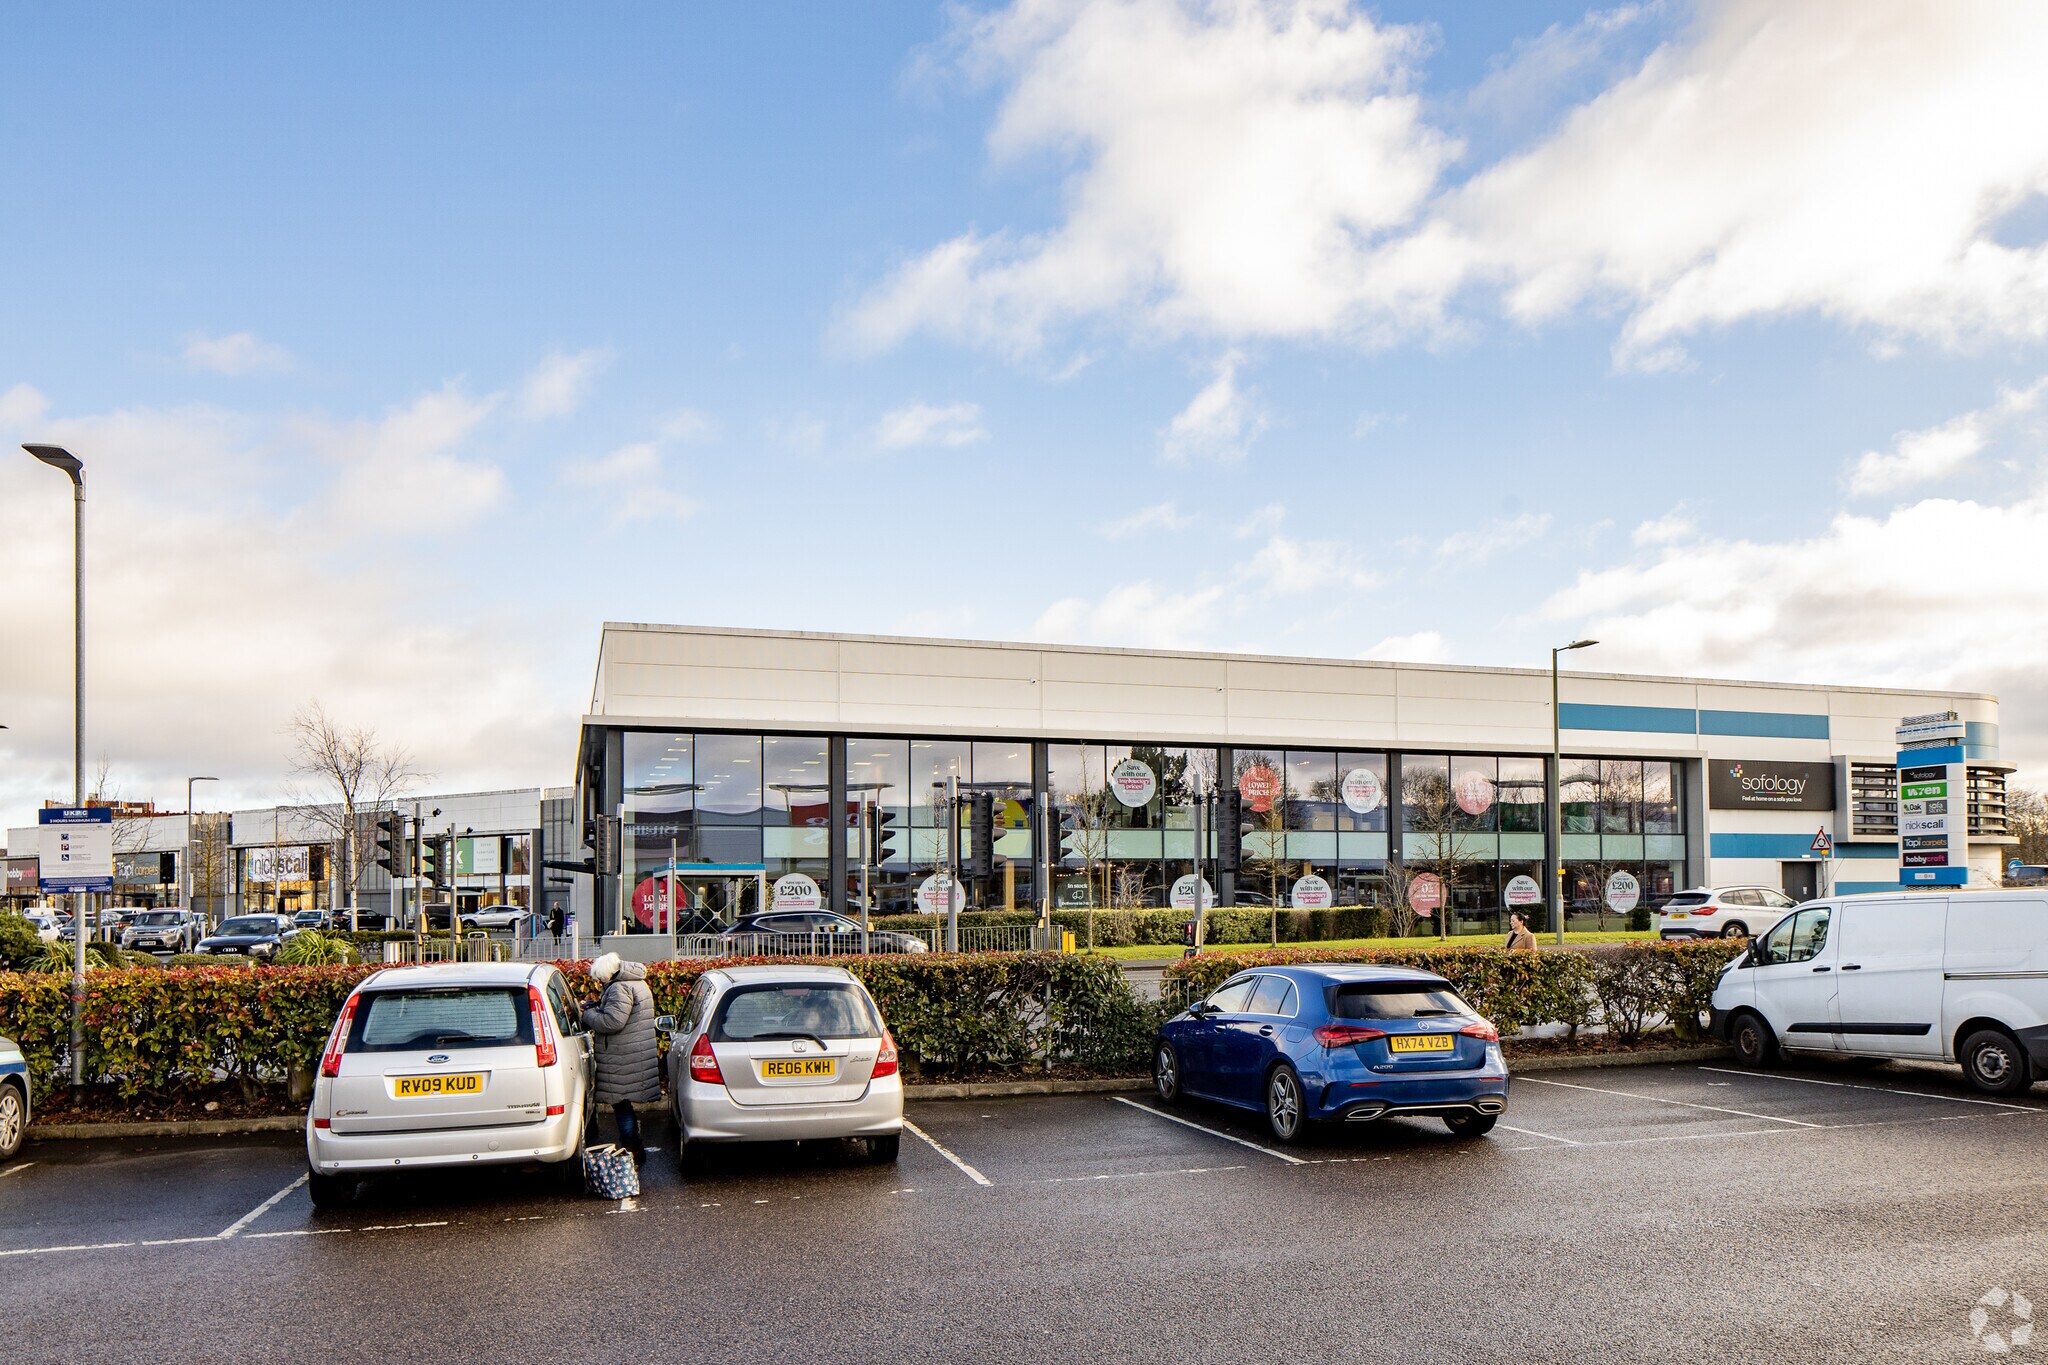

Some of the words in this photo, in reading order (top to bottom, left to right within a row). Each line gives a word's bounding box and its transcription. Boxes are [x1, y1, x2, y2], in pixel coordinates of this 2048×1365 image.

[1913, 771, 1936, 779] sofology
[1741, 774, 1806, 795] sofology
[1909, 803, 1922, 811] Oak
[1904, 837, 1921, 848] Tapi
[1921, 839, 1947, 847] carpets
[1905, 854, 1945, 864] hobbycraft
[134, 865, 160, 881] carpets
[780, 885, 812, 896] £200
[1612, 881, 1634, 890] £200
[1396, 1037, 1425, 1049] HX74
[1427, 1036, 1449, 1048] VZB
[768, 1062, 802, 1075] RE06
[805, 1061, 830, 1074] KWH
[401, 1078, 442, 1094] RV09
[446, 1076, 476, 1091] KUD
